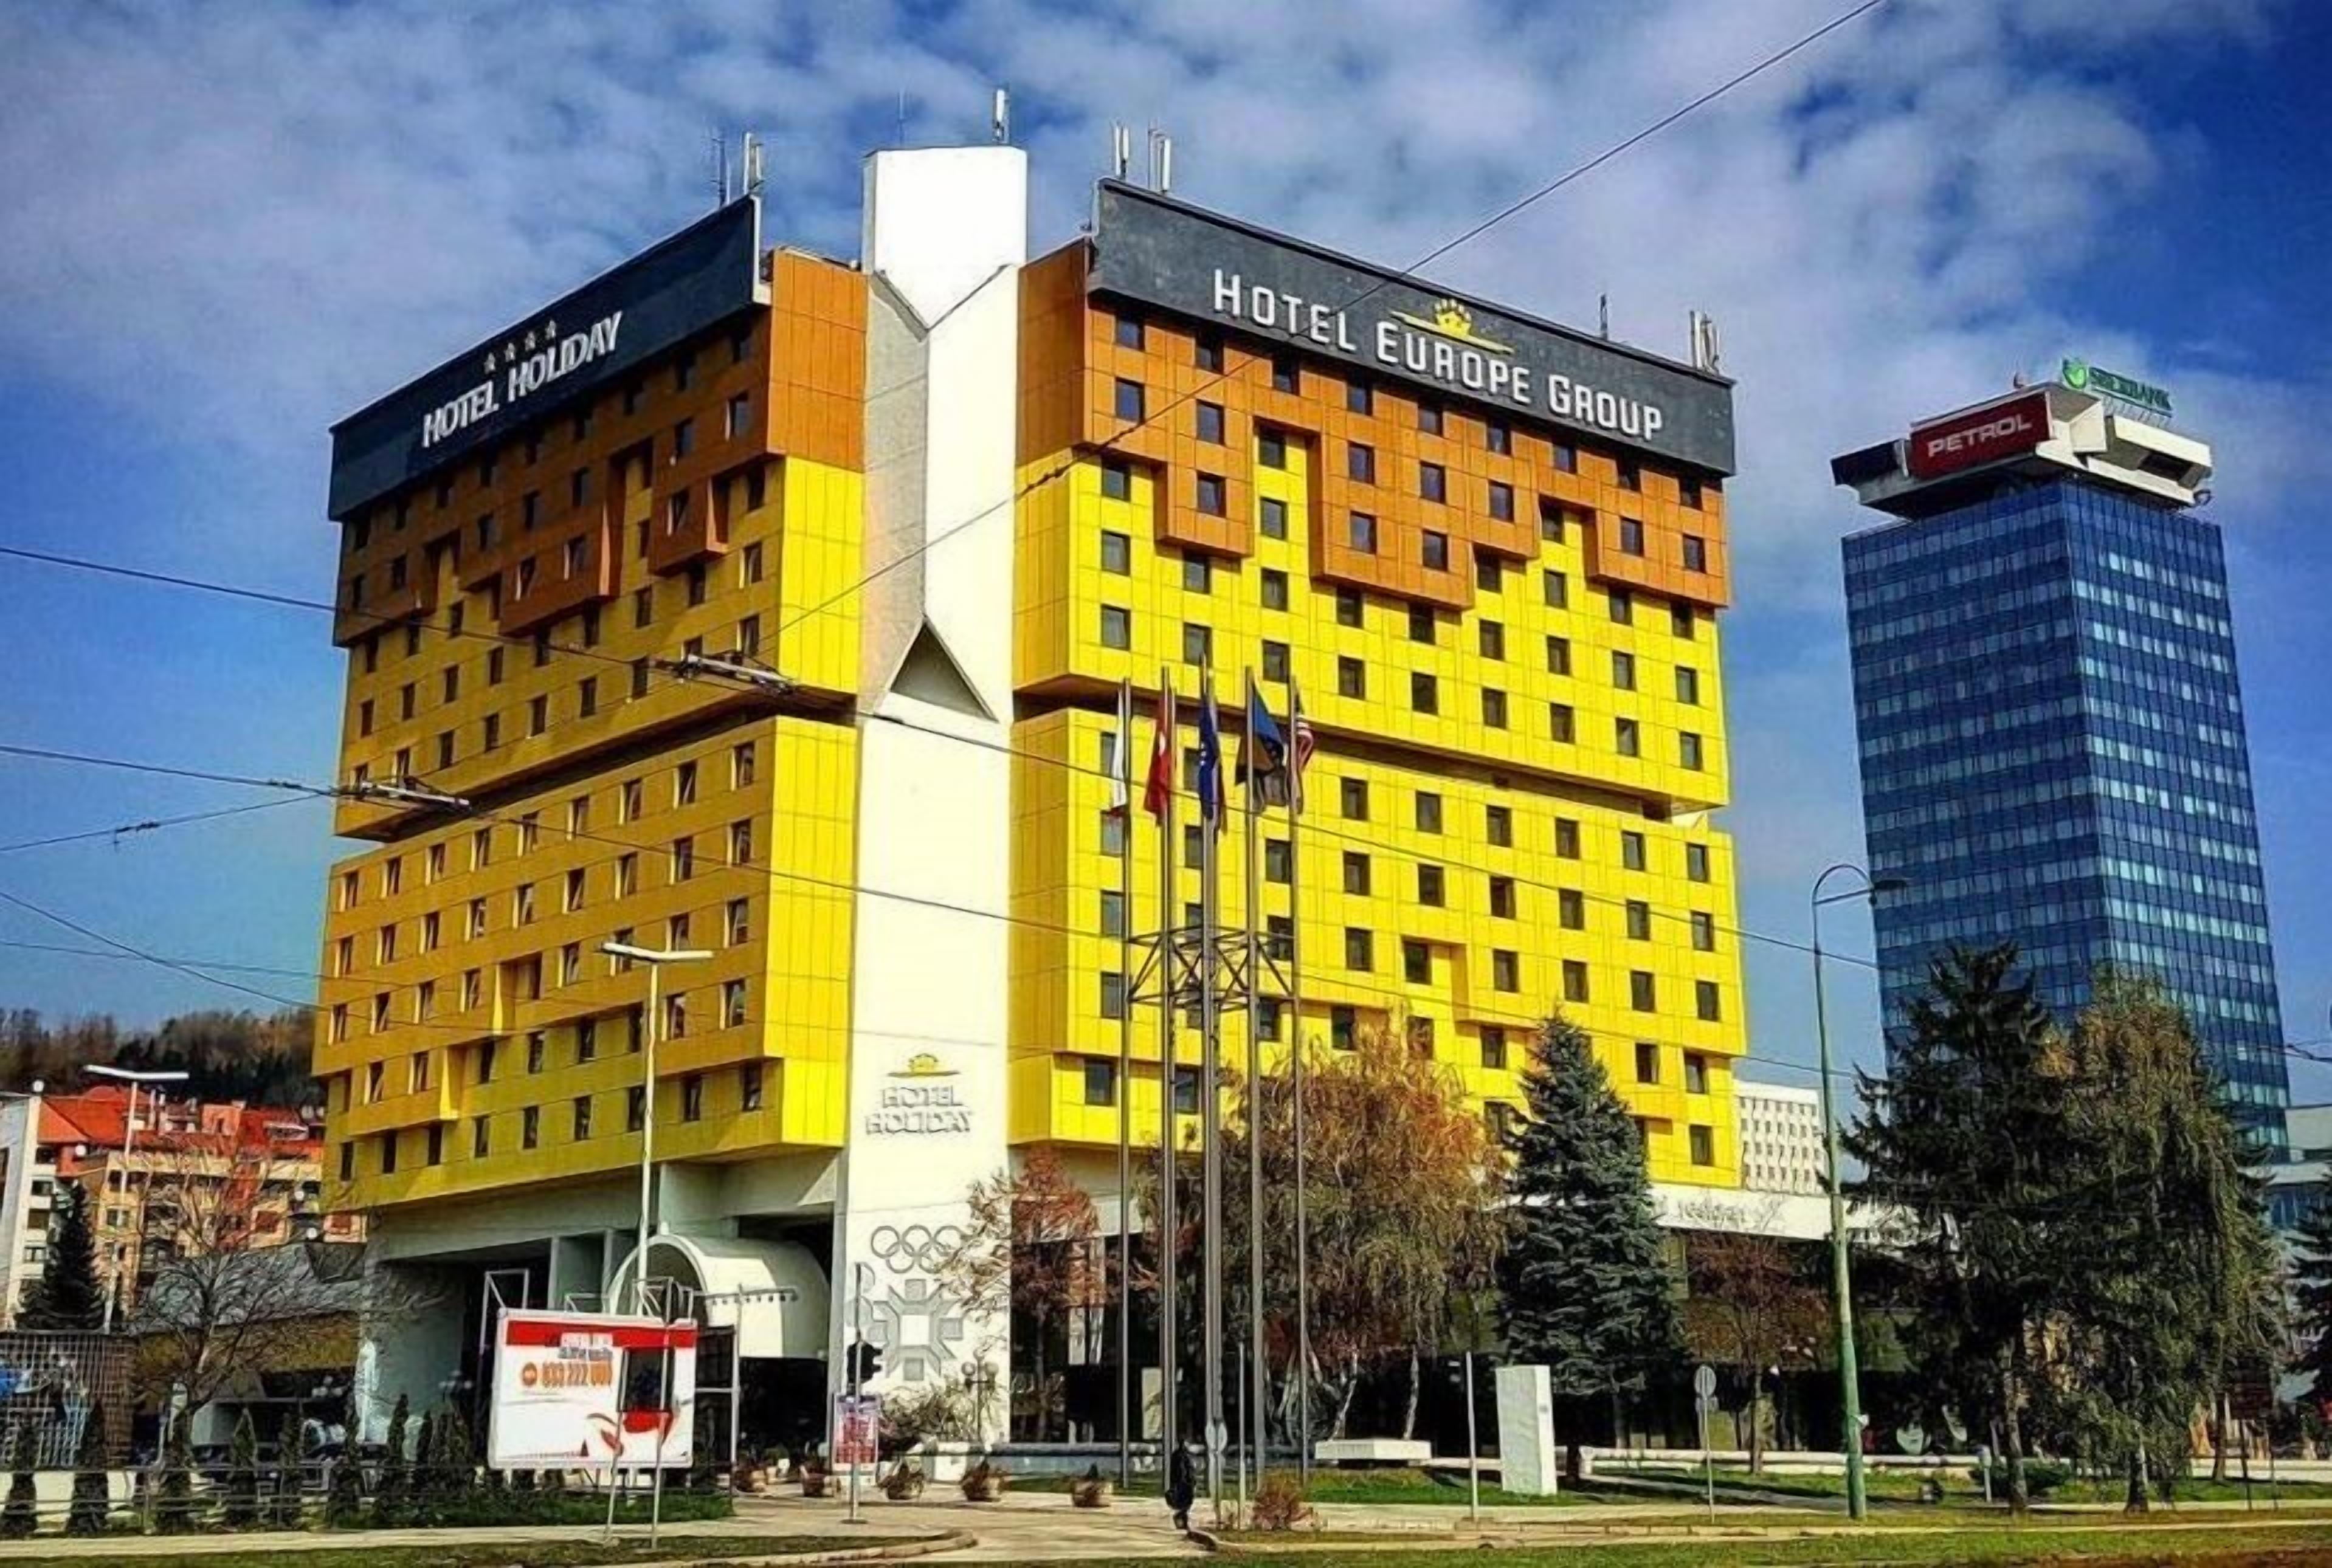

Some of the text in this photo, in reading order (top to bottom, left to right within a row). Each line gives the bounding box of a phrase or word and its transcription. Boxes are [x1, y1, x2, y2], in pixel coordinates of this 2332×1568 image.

[423, 311, 623, 447] HOTEL HOLIDAY
[1213, 268, 1663, 441] HOTEL EUROPE GROUP
[1927, 414, 2032, 458] PETROL
